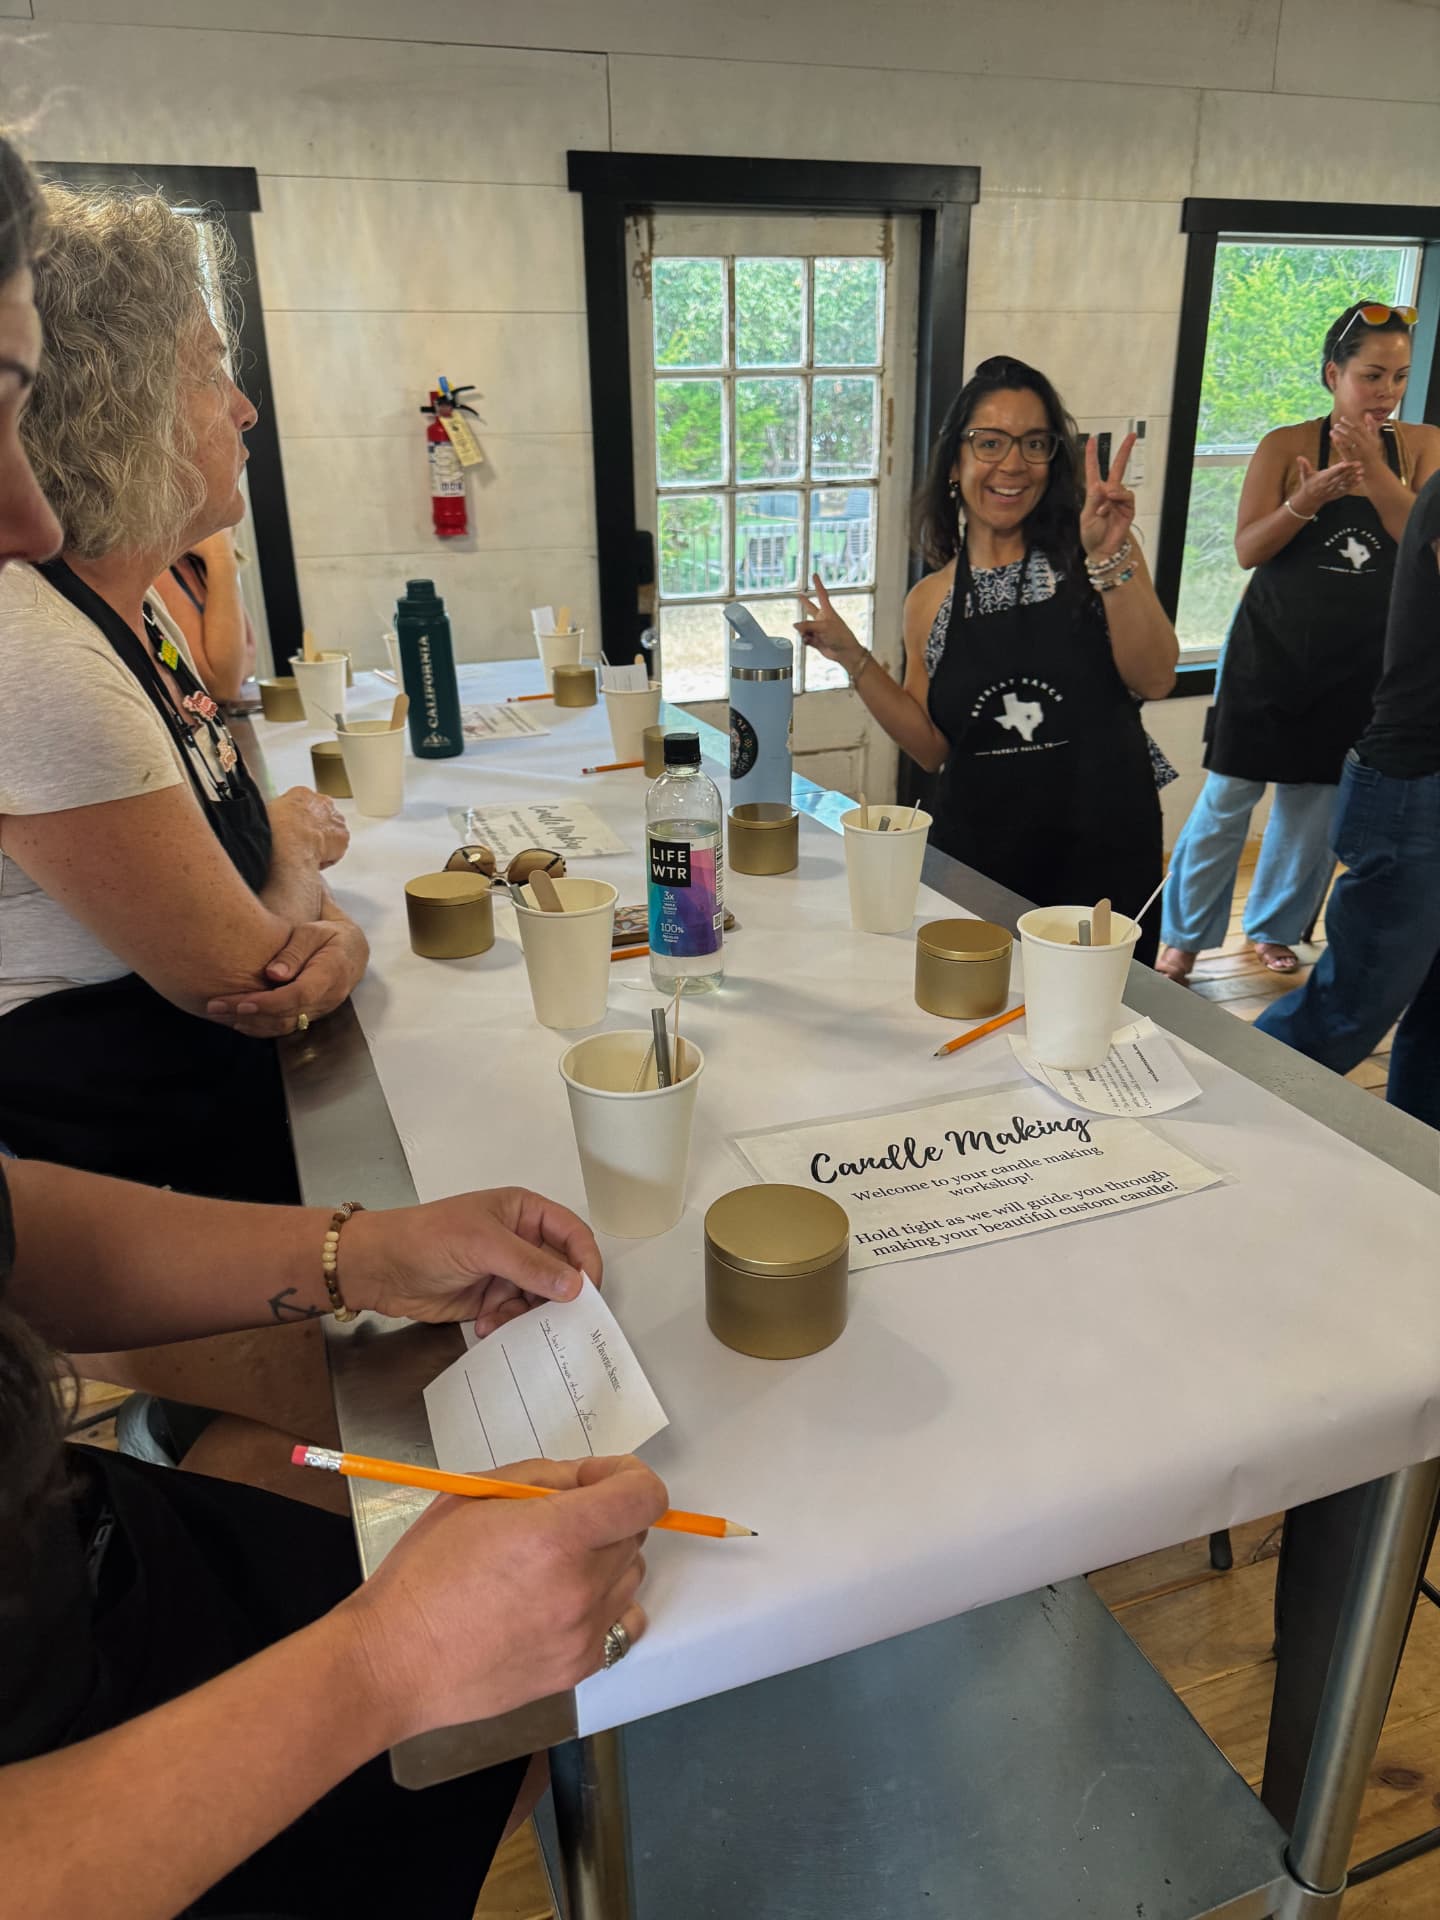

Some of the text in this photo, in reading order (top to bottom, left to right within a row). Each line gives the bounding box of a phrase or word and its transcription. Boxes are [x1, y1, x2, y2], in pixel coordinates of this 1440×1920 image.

[418, 634, 439, 729] CALIFORNIA
[652, 847, 687, 863] LIFE
[652, 864, 687, 880] WTR
[660, 922, 685, 934] 100%
[811, 1116, 1092, 1184] Candle Making
[851, 1146, 1104, 1201] Welcome to your candle making
[949, 1172, 1034, 1197] workshop!
[855, 1170, 1171, 1245] Hold tight as we will guide you through
[872, 1181, 1179, 1257] making your beautiful custom candle!
[591, 1328, 602, 1345] My
